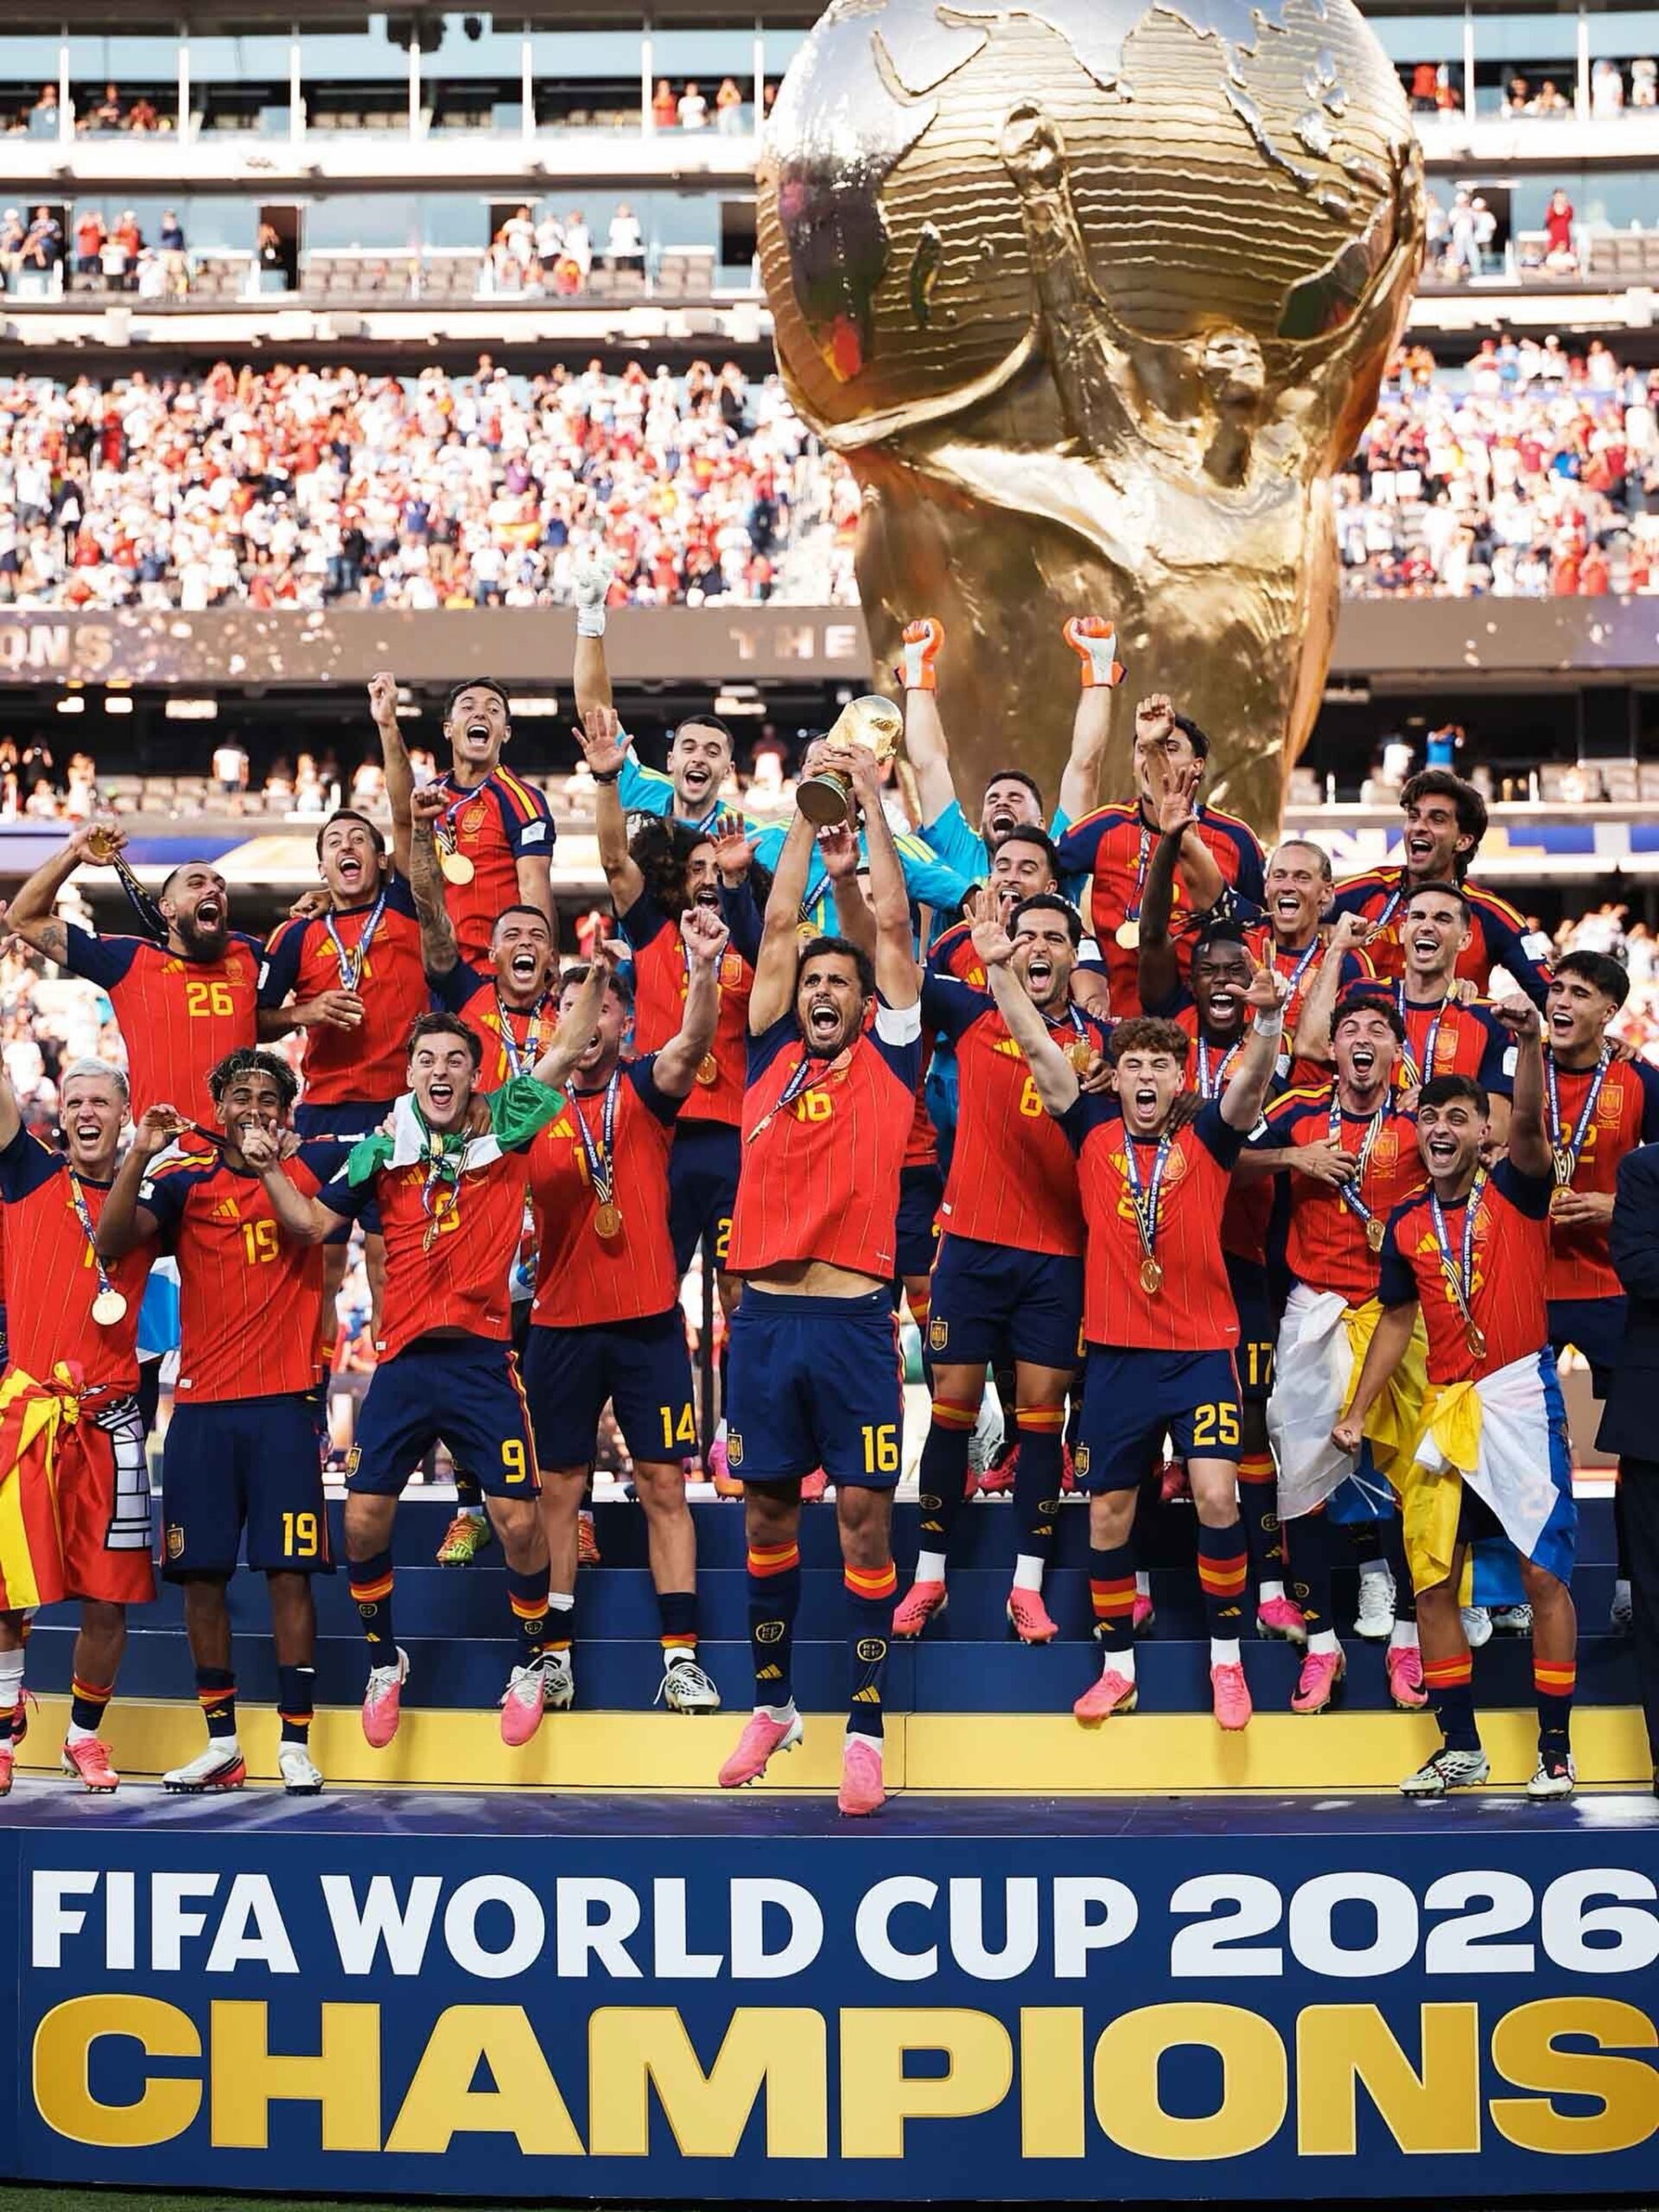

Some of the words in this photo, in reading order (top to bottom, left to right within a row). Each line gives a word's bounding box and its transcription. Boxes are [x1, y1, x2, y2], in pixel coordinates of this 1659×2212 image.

[0, 624, 112, 668] ONS
[729, 625, 856, 659] THE
[186, 982, 234, 1017] 26
[1020, 1076, 1043, 1117] 6
[242, 1219, 279, 1265] 19
[1248, 1343, 1273, 1384] 17
[660, 1402, 696, 1449] 14
[1193, 1402, 1239, 1446] 25
[501, 1439, 526, 1484] 9
[861, 1424, 899, 1474] 16
[283, 1512, 318, 1556] 19
[32, 1871, 300, 1974] FIFA
[320, 1874, 824, 1979] WORLD
[855, 1875, 1139, 1981] CUP
[1169, 1868, 1659, 1978] 2026
[33, 1993, 1659, 2158] CHAMPIONS
